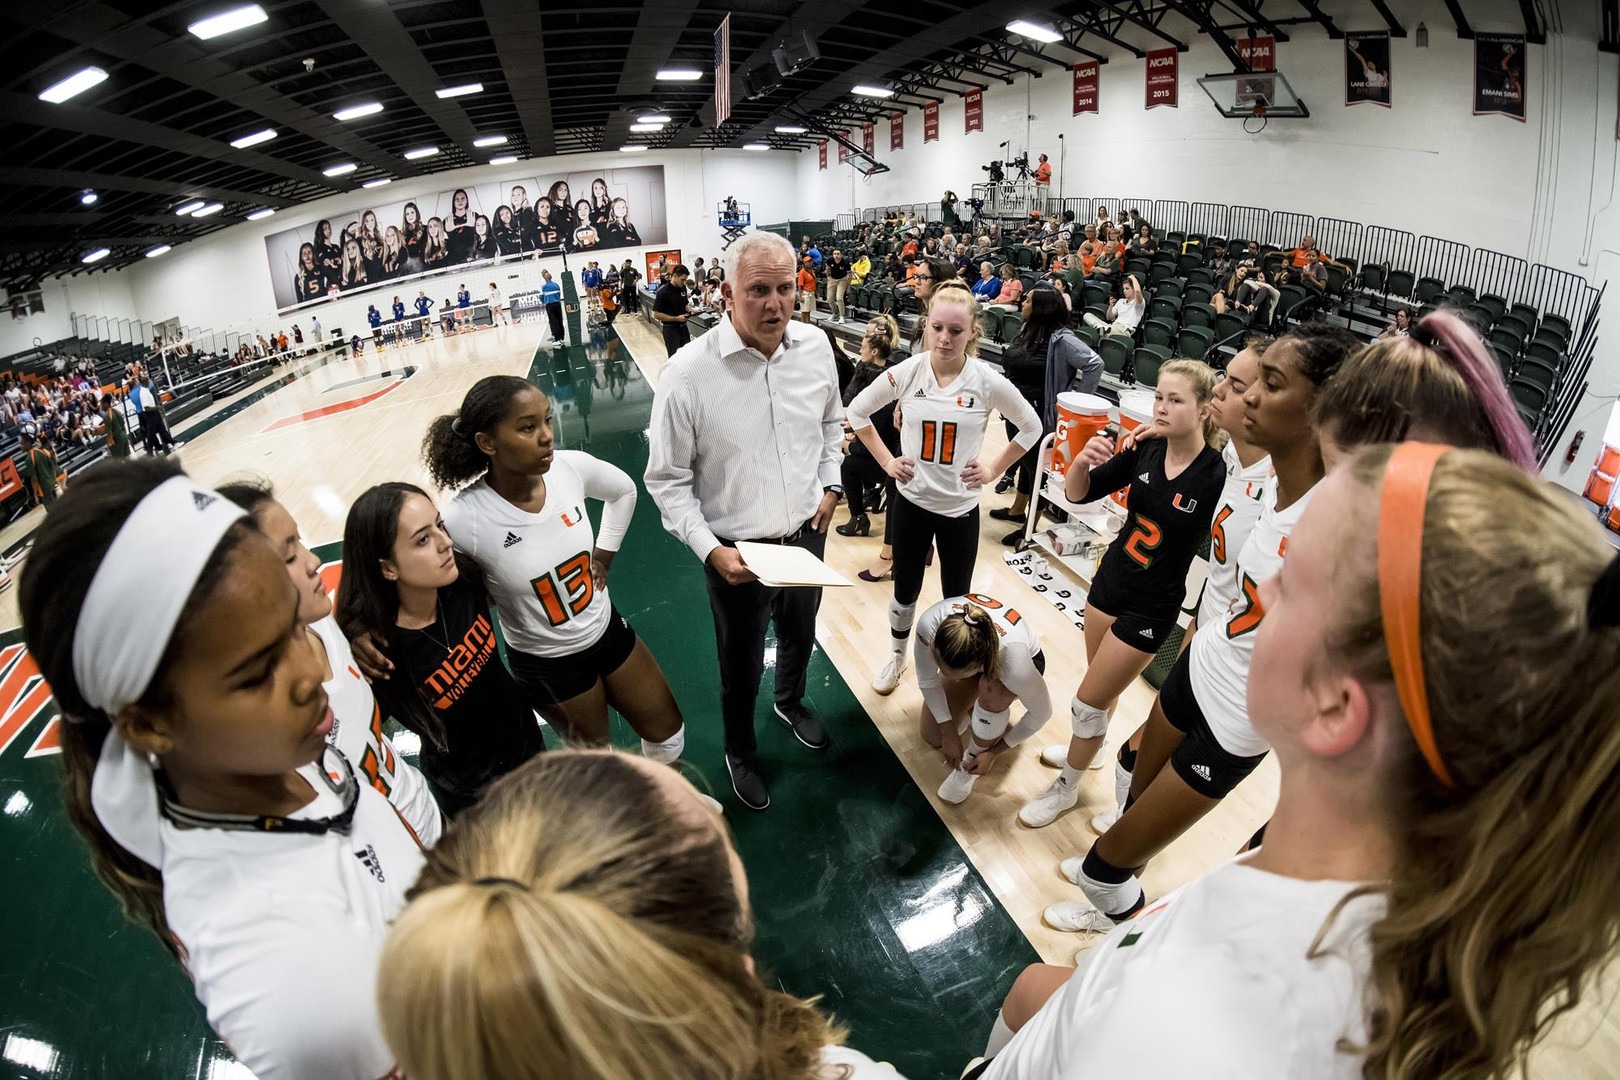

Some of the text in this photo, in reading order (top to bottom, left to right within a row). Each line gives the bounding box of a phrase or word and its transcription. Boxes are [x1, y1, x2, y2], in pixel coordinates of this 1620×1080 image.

[1149, 57, 1174, 68] NCAA
[1076, 67, 1096, 79] NCAA
[1153, 90, 1170, 98] 2015
[1482, 88, 1503, 97] EMANI
[1079, 98, 1093, 106] 2014
[540, 230, 558, 244] 12
[308, 279, 320, 294] 5
[956, 396, 975, 408] U
[1056, 419, 1069, 441] G
[920, 420, 958, 466] 11
[1172, 493, 1198, 513] U
[560, 506, 582, 527] U
[1123, 513, 1163, 570] 2
[1211, 503, 1234, 565] 6
[530, 550, 595, 627] 13
[1054, 590, 1071, 598] G
[1191, 764, 1212, 781] adidas
[366, 844, 385, 884] adidas
